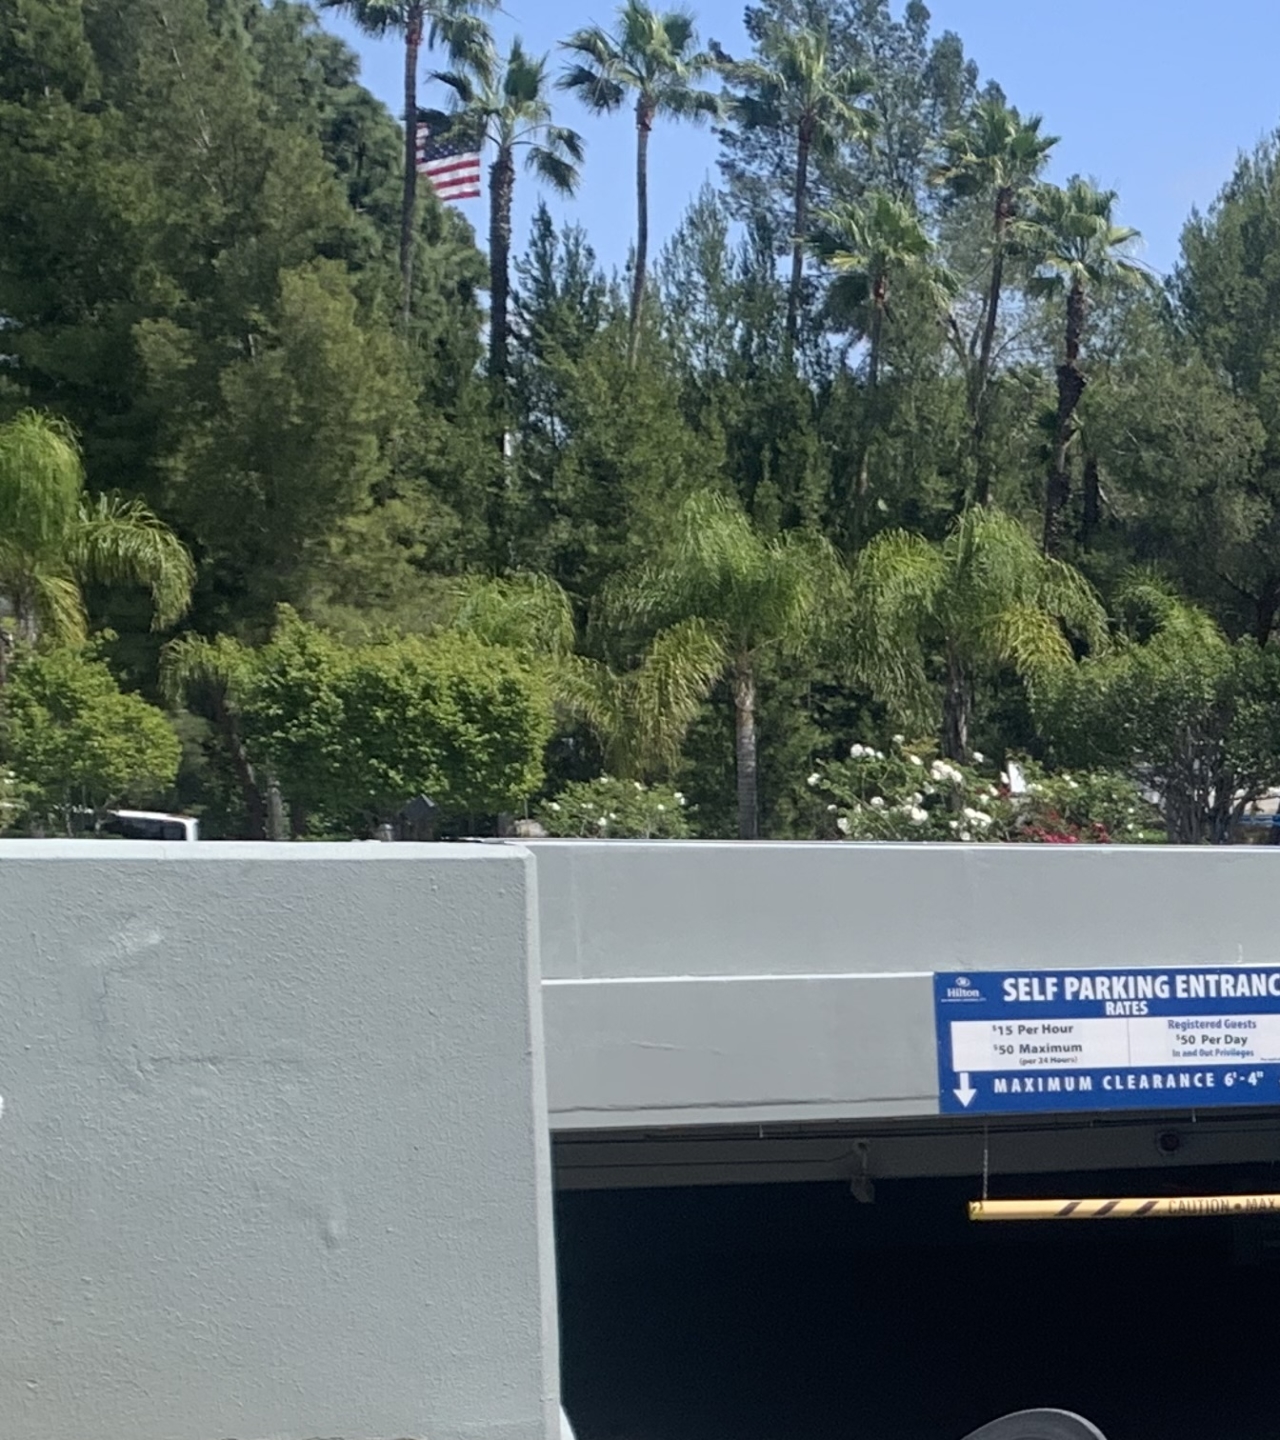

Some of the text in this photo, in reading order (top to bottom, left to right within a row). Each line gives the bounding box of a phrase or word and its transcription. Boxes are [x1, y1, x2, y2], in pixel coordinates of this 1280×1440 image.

[946, 987, 980, 998] Hilton
[1003, 977, 1058, 1002] SELF
[1064, 974, 1170, 1001] PARKING
[1105, 1000, 1149, 1016] RATES
[992, 1023, 1074, 1036] $15 Per Hour
[1167, 1018, 1257, 1031] Registered Guests
[1176, 1034, 1248, 1047] $50 Per Day
[993, 1042, 1083, 1055] $50 Maximum
[1172, 1049, 1180, 1057] In
[1182, 1048, 1198, 1057] and
[1199, 1048, 1214, 1057] Out
[1215, 1047, 1254, 1059] Privileges
[1019, 1057, 1037, 1066] (per
[1038, 1057, 1048, 1065] 24
[994, 1075, 1093, 1094] MAXIMUM
[1103, 1072, 1215, 1091] CLEARANCE
[1168, 1198, 1230, 1214] CAUTION
[1246, 1197, 1275, 1212] MAX
